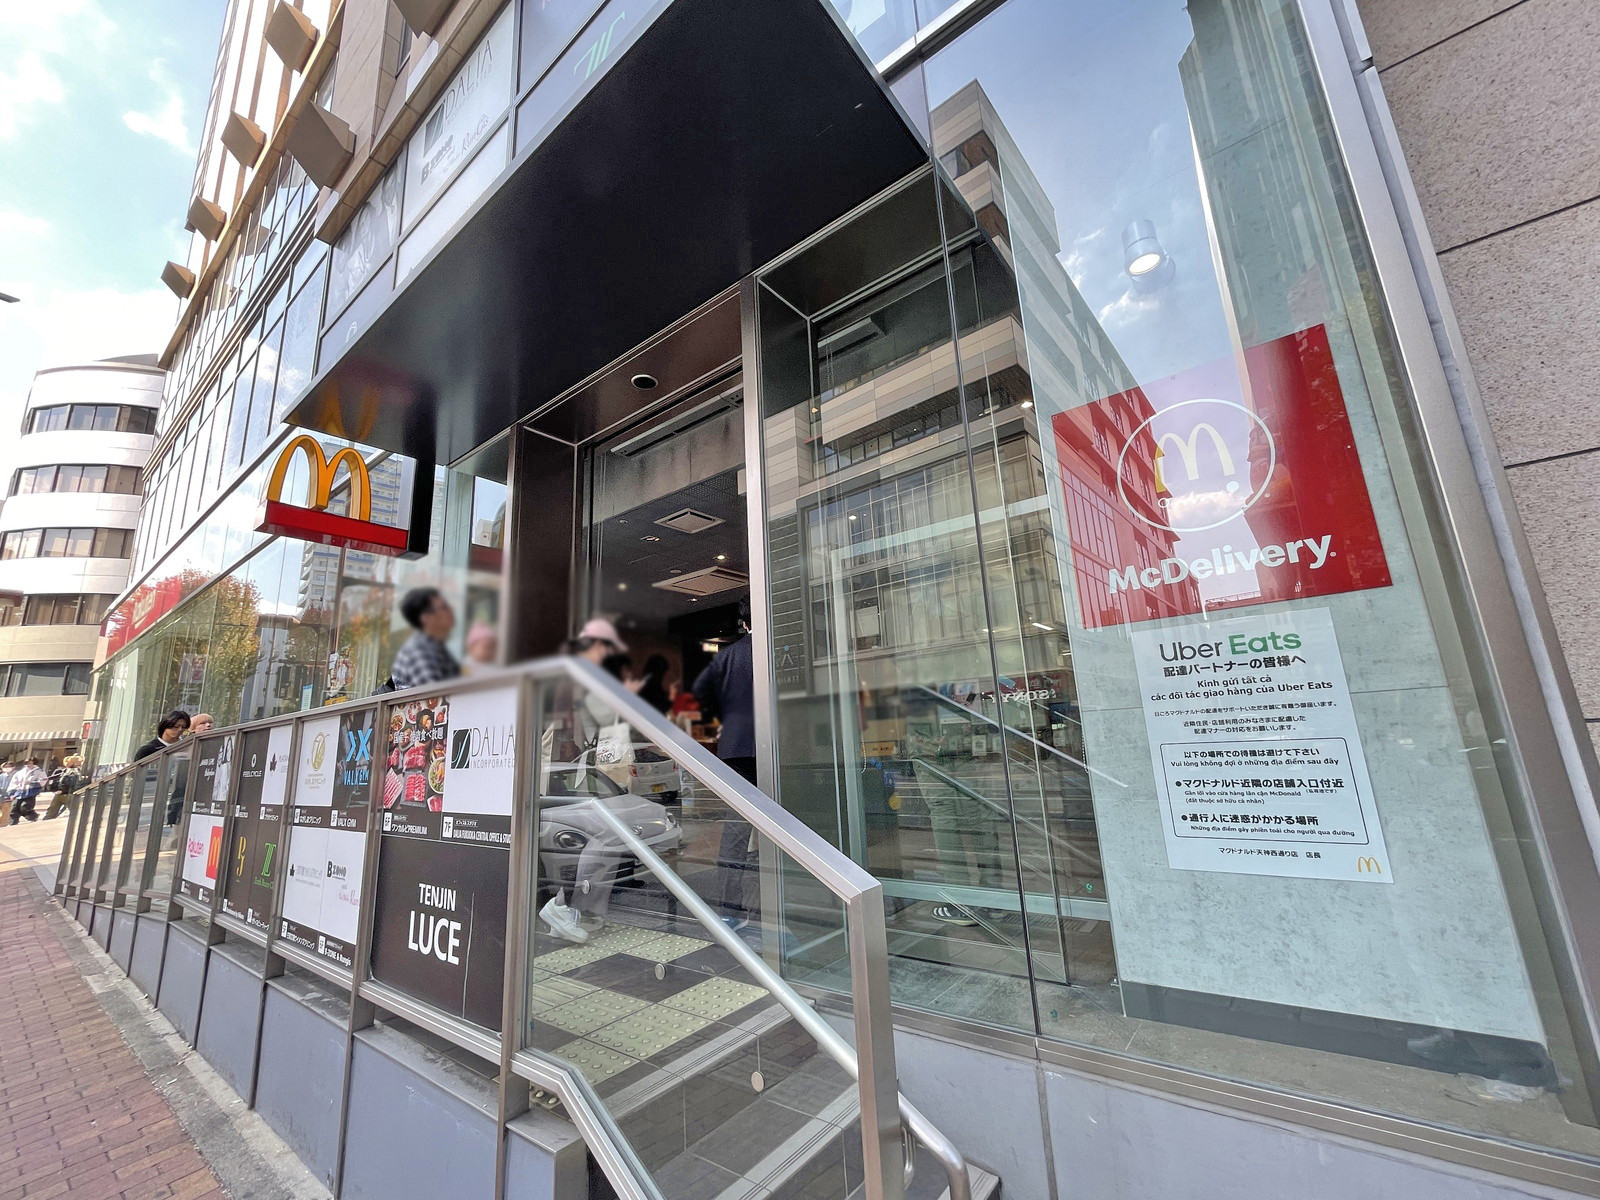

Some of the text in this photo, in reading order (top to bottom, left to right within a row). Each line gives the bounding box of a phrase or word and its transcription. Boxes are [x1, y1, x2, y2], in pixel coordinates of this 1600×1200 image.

[444, 39, 493, 120] DALIA
[1108, 534, 1331, 594] McDelivery
[1158, 631, 1302, 662] Uber Eats
[1163, 655, 1306, 678] 配達パートナーの皆様へ
[1203, 689, 1225, 700] giao
[1277, 682, 1305, 692] Uber
[1307, 680, 1333, 690] Eats
[471, 725, 515, 757] DALIA
[1182, 778, 1345, 789] マクドナルド近隣の店舗入口付近
[418, 882, 457, 912] TENJIN
[408, 910, 461, 966] LUCE
